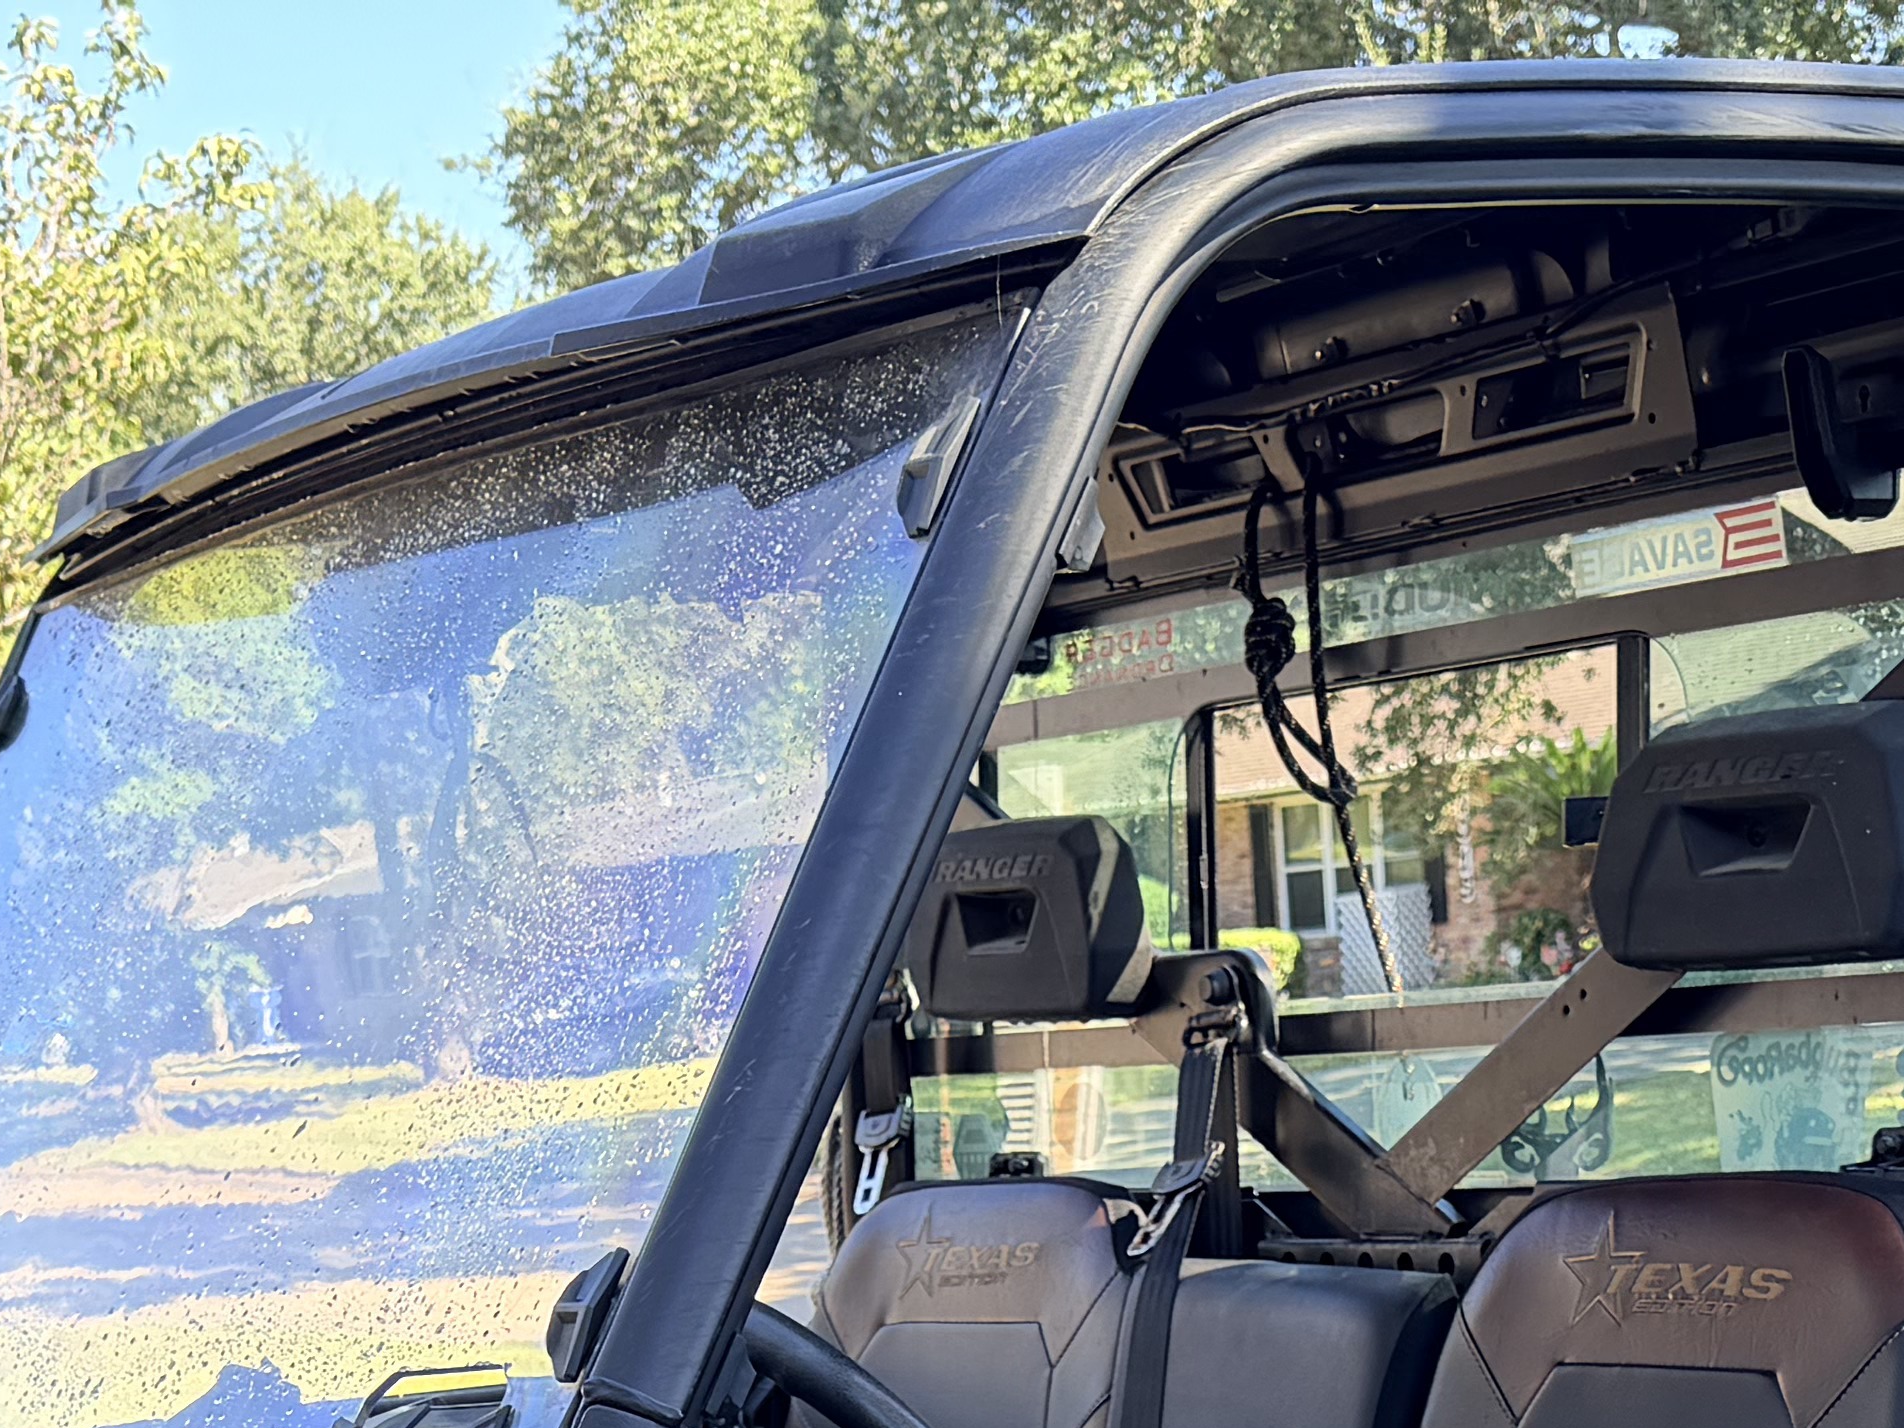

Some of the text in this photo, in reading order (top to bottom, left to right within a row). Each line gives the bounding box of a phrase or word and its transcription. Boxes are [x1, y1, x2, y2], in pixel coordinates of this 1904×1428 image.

[934, 854, 1055, 883] RANGER
[924, 1241, 1041, 1272] TEXAS
[1606, 1263, 1793, 1300] TEXAS
[1632, 1299, 1739, 1317] EDITION
